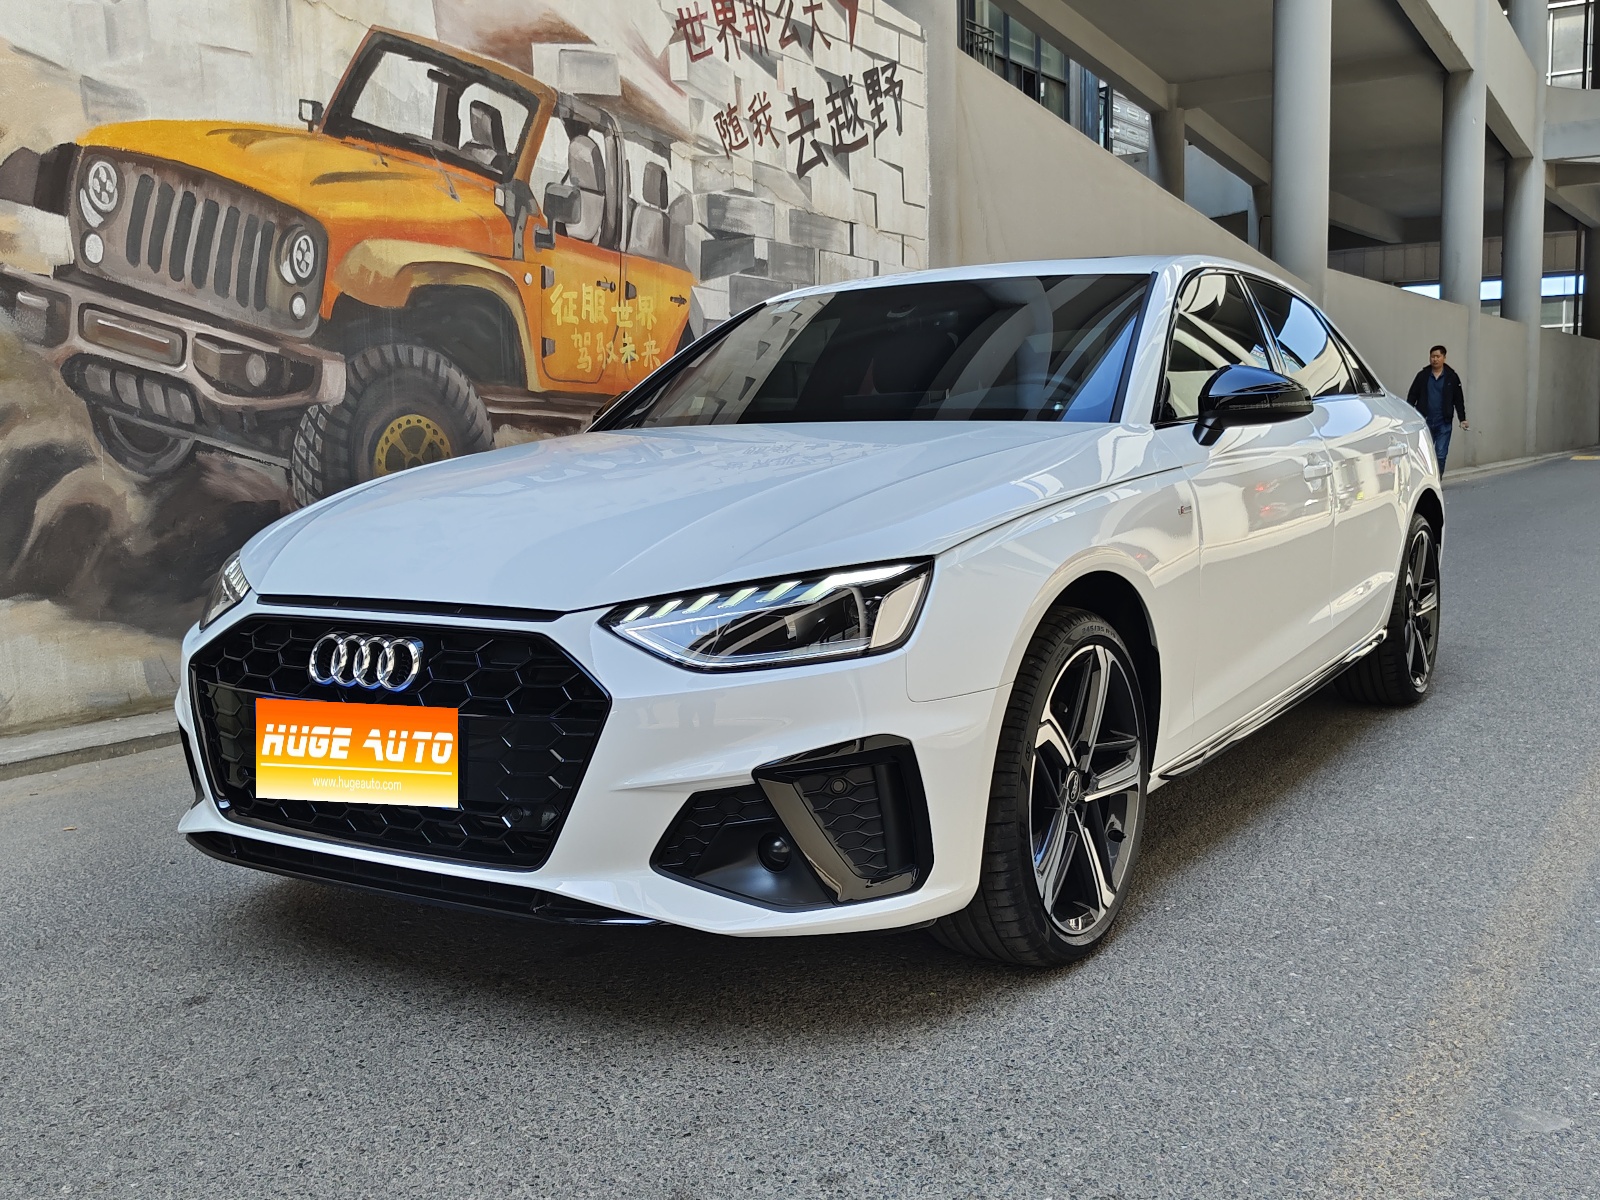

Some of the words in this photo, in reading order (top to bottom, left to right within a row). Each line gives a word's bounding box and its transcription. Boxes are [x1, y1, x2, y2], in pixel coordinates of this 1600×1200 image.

[676, 0, 832, 63] 世界那么大
[713, 61, 904, 180] 随我去越野
[549, 283, 658, 331] 征服世界
[570, 327, 662, 373] 驾驭未来
